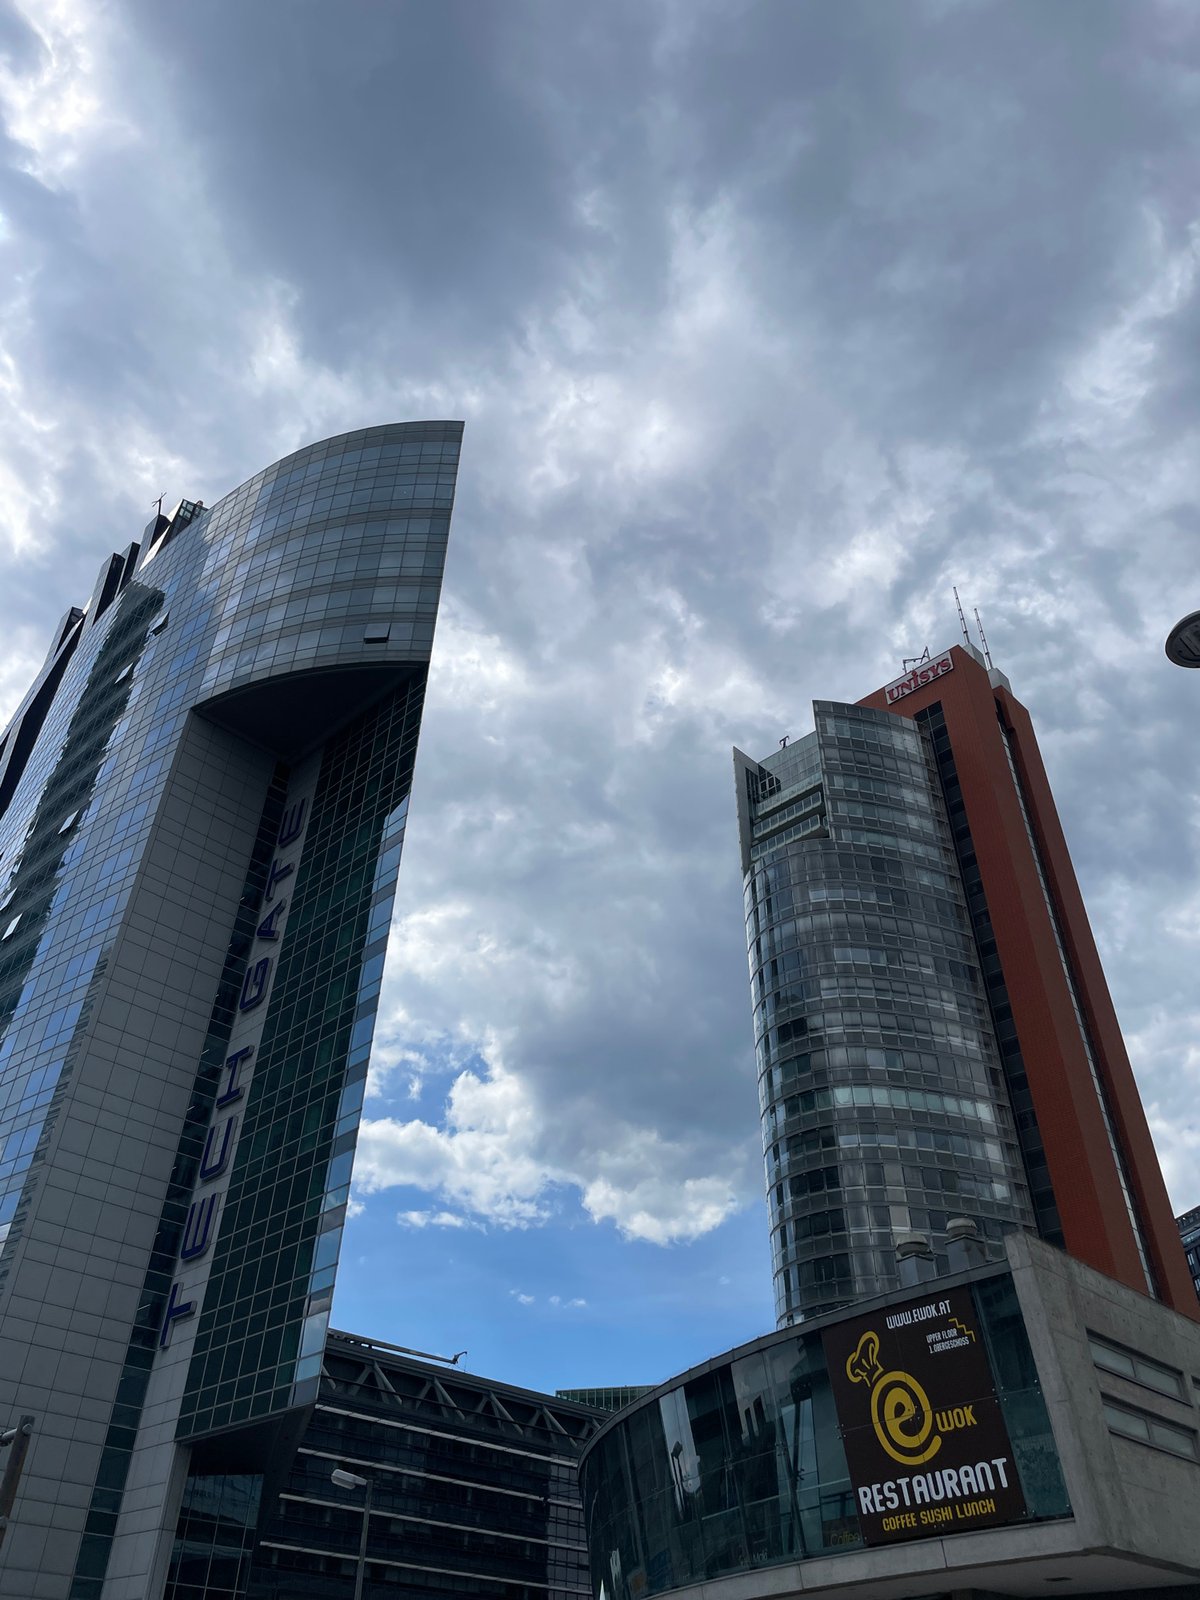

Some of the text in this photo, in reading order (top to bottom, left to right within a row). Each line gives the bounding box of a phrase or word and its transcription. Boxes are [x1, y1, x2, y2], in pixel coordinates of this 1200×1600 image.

[159, 797, 308, 1349] TECH GATE
[886, 1300, 952, 1330] WWW.EWOK.AT
[926, 1328, 958, 1344] UPPER FLOOR
[858, 1457, 1009, 1515] RESTAURANT
[882, 1498, 996, 1532] COFFEE SUSHI LUNCH
